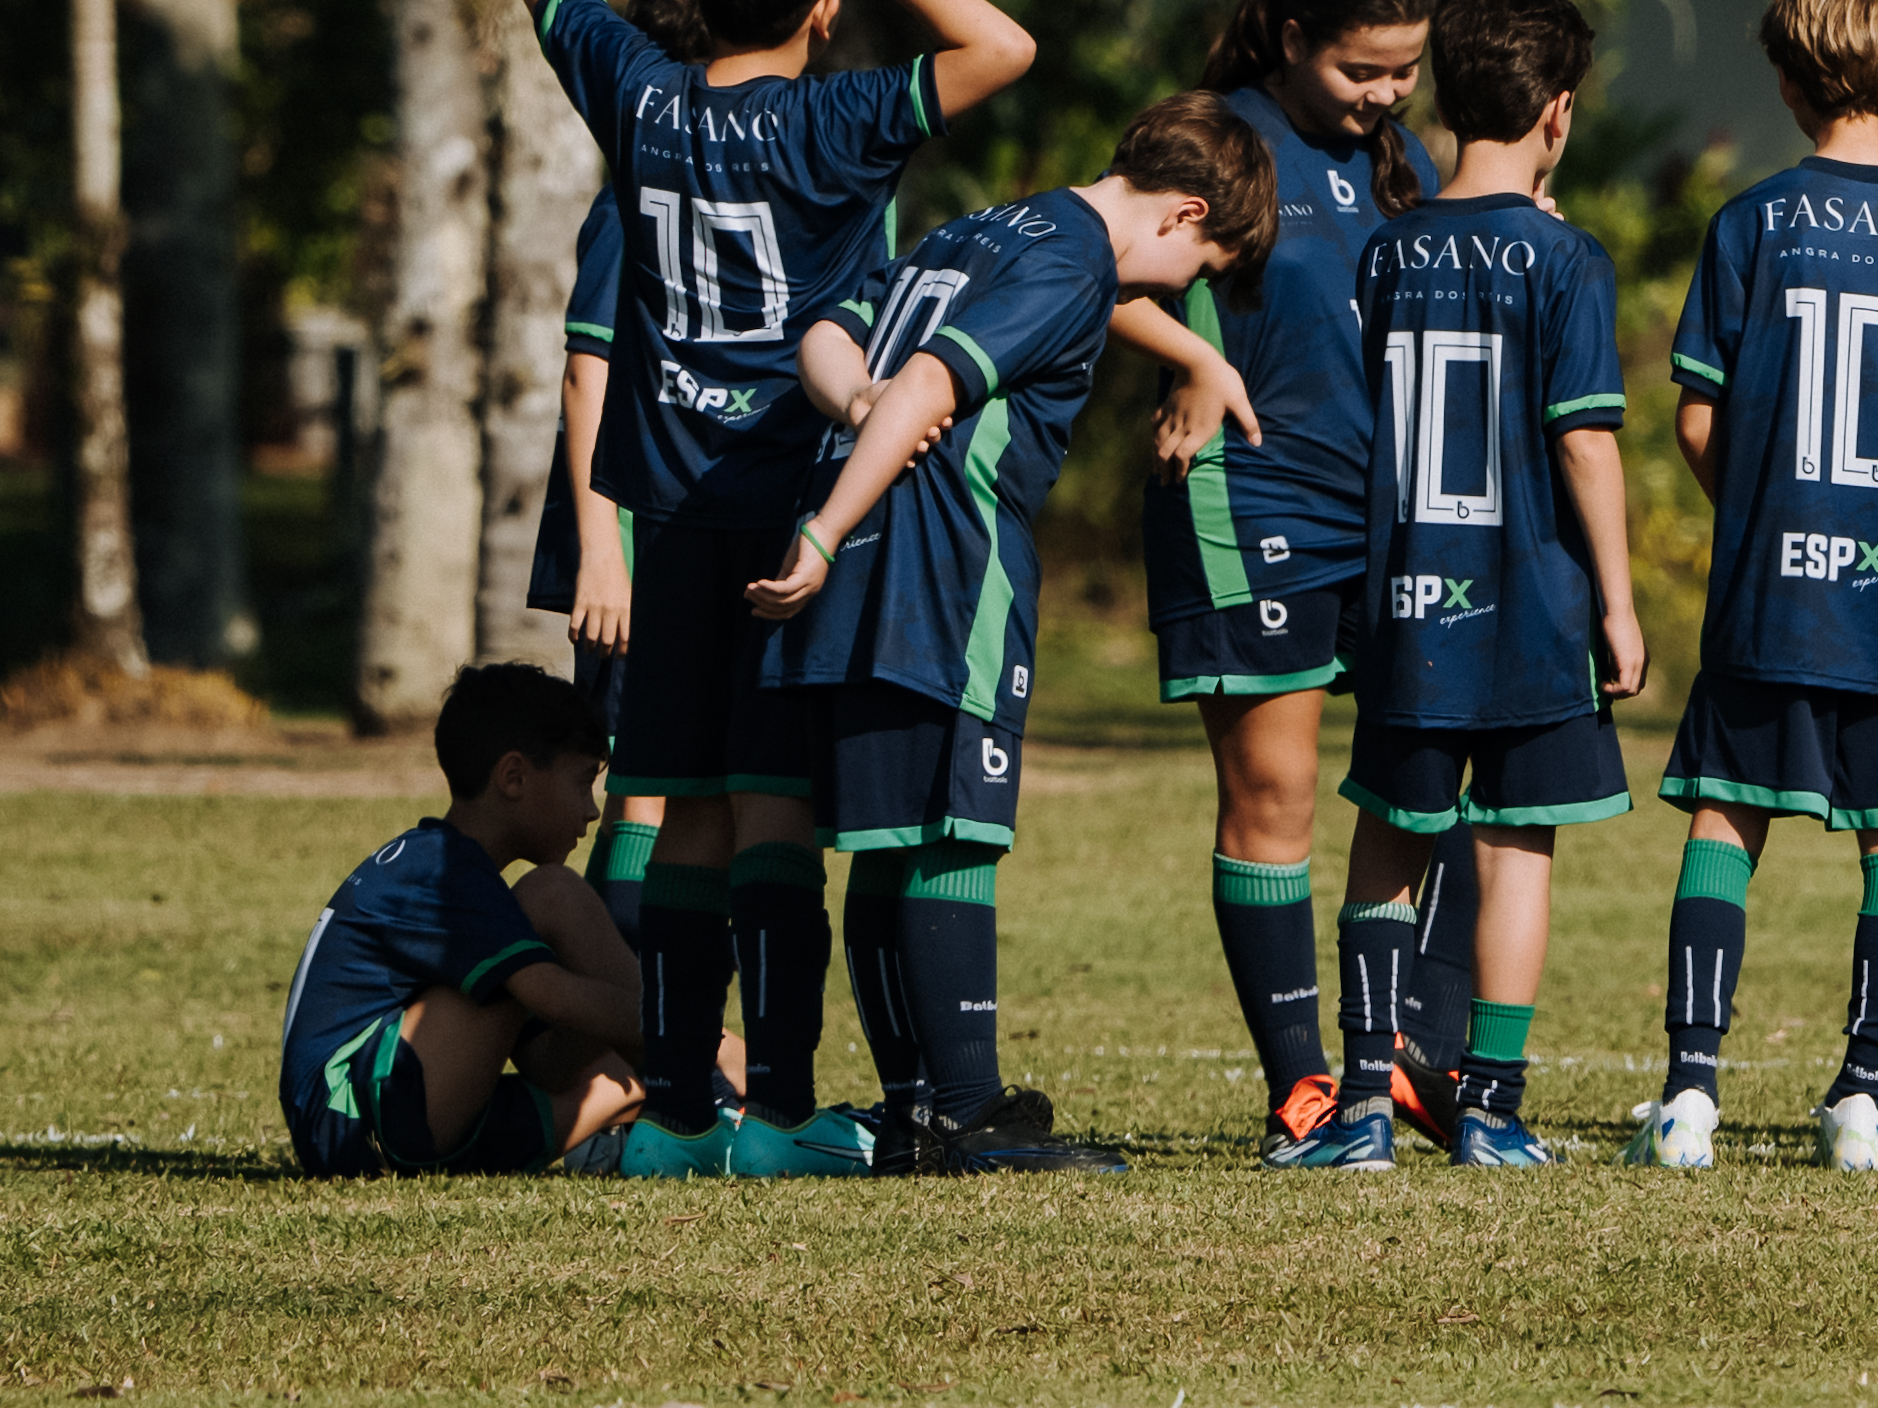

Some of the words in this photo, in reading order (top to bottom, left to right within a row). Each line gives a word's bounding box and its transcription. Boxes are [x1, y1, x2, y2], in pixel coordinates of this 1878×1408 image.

[973, 233, 1002, 254] REIS
[1779, 247, 1840, 261] ANGRA
[640, 186, 790, 342] 10
[1370, 234, 1536, 278] FASANO
[1384, 330, 1503, 526] 10
[1440, 603, 1496, 629] experience
[1271, 985, 1319, 1004] Batbol
[960, 1000, 998, 1011] Batb
[1359, 1058, 1395, 1072] Batbol
